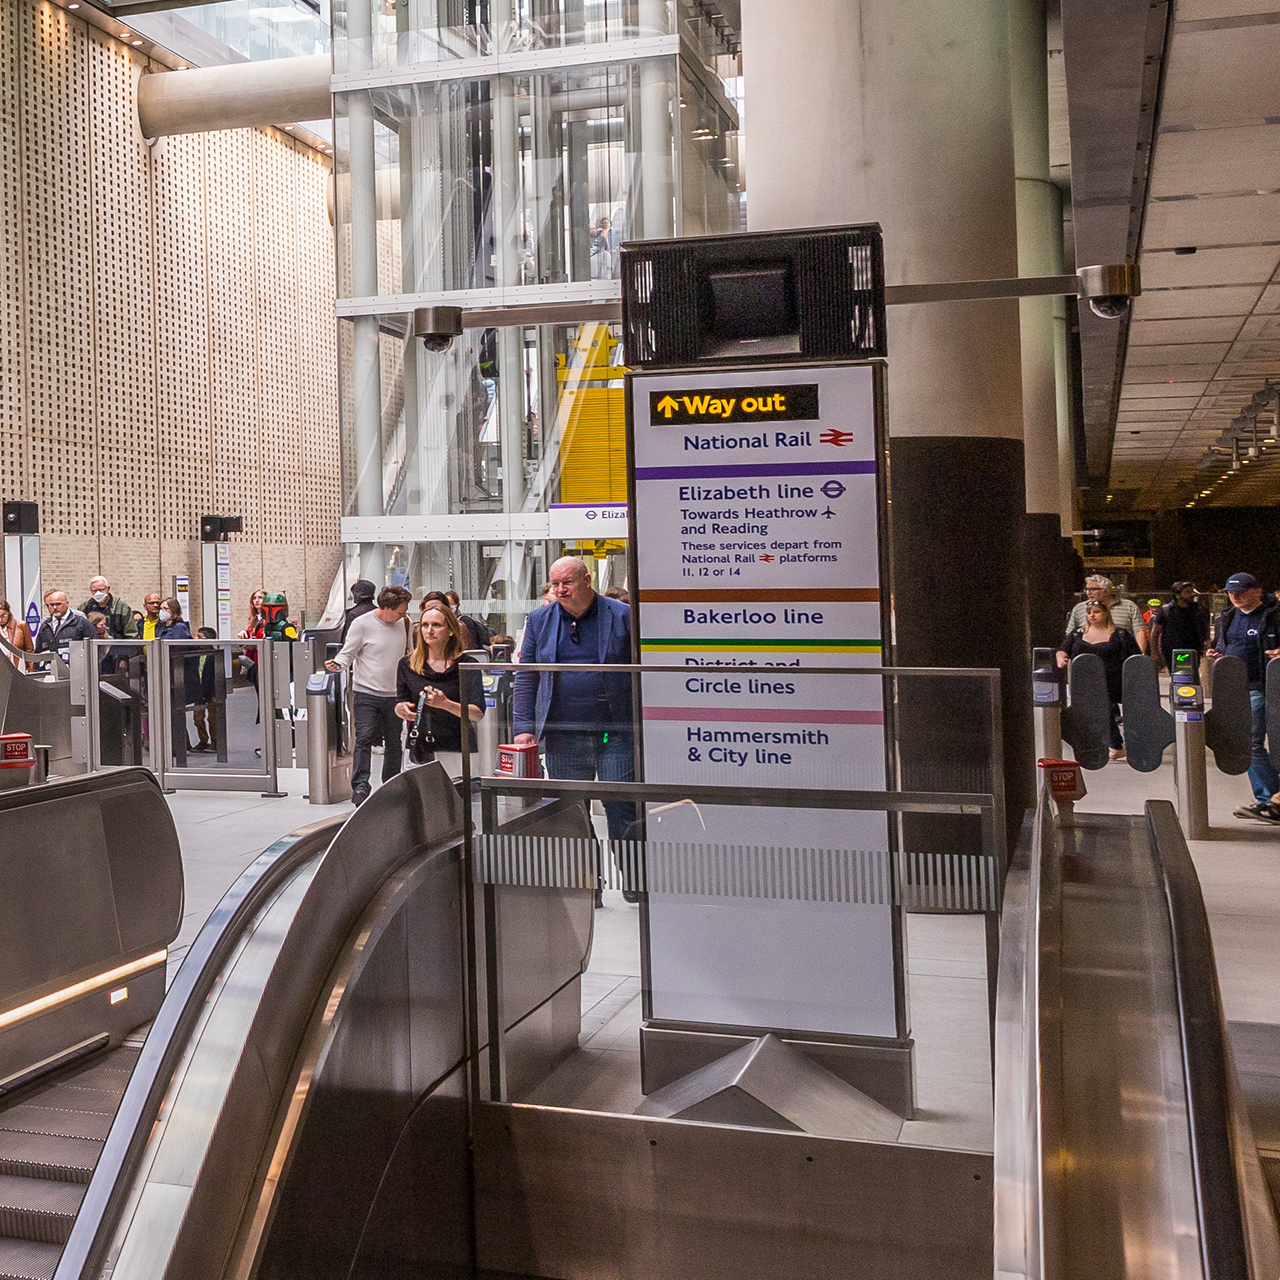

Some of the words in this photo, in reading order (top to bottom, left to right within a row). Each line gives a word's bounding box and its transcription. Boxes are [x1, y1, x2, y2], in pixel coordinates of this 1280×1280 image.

[683, 395, 736, 418] Way
[741, 393, 786, 413] out
[684, 433, 769, 450] National
[775, 431, 812, 447] Rail
[679, 485, 770, 501] Elizabeth
[778, 484, 814, 499] line
[601, 511, 628, 519] Eliza
[680, 508, 739, 520] Towards
[745, 507, 817, 519] Heathrow
[681, 523, 706, 535] and
[712, 523, 768, 536] Reading
[682, 541, 715, 551] These
[719, 541, 766, 550] services
[770, 540, 809, 551] depart
[813, 539, 842, 549] from
[682, 554, 730, 564] National
[735, 554, 755, 563] Rail
[779, 553, 837, 564] platforms
[682, 568, 694, 577] 11,
[699, 567, 709, 576] 12
[729, 567, 740, 576] 14
[683, 609, 777, 624] Bakerloo
[784, 609, 824, 624] line
[685, 678, 741, 693] Circle
[748, 679, 795, 694] lines
[687, 727, 829, 745] Hammersmith
[6, 743, 26, 751] STOP
[687, 747, 702, 762] &
[708, 747, 748, 767] City
[755, 748, 792, 764] line
[1052, 772, 1074, 781] STOP
